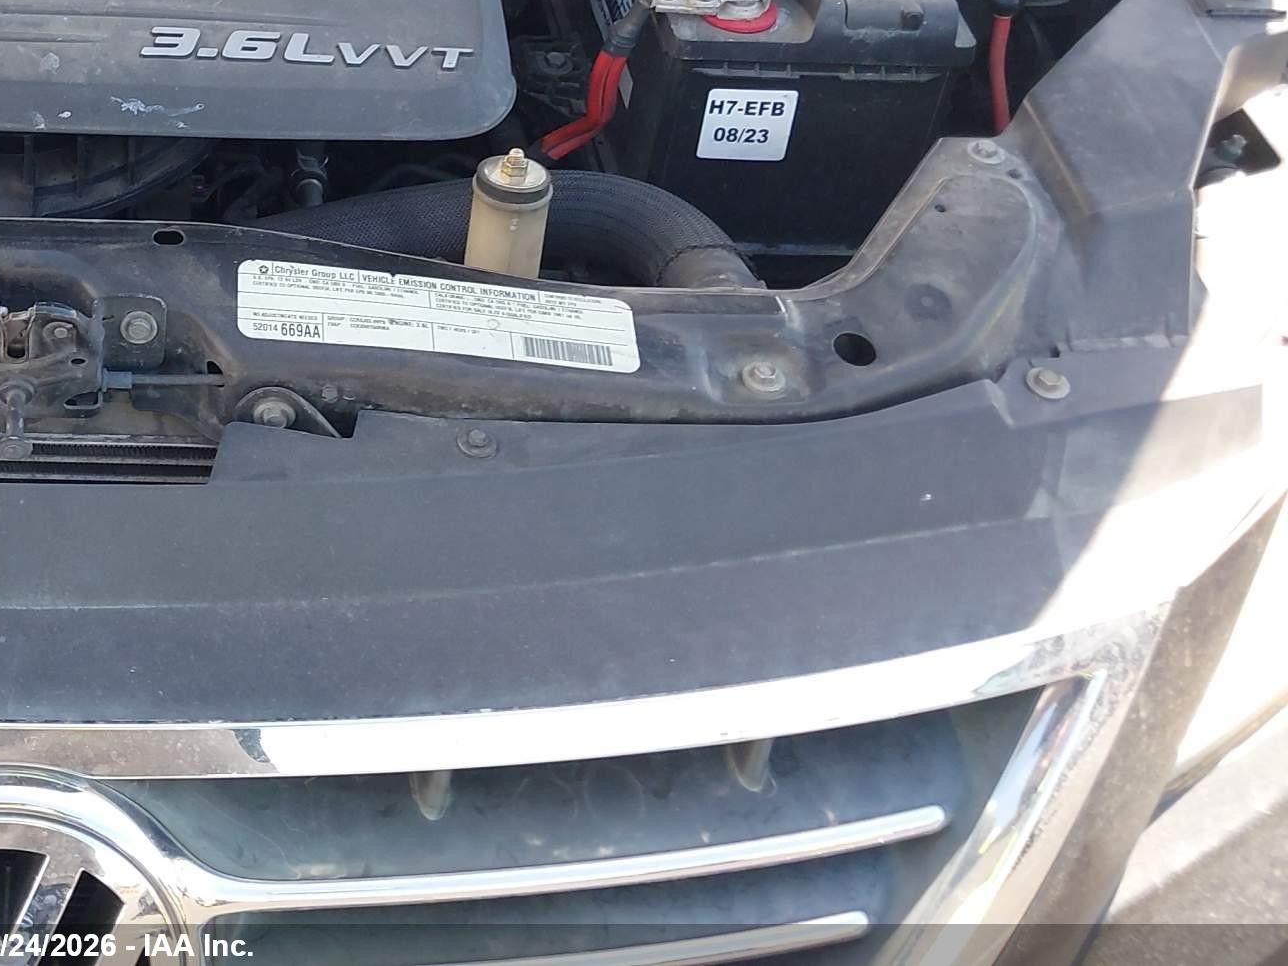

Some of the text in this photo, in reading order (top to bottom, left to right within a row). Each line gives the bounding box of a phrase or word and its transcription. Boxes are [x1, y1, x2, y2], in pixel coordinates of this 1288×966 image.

[708, 100, 786, 117] H7-EFB
[713, 127, 770, 144] 08/23
[274, 265, 309, 277] Chrysler
[311, 268, 337, 281] Group
[339, 272, 355, 281] LLC
[362, 273, 395, 285] VEHICLE
[398, 278, 438, 290] EMISSION
[440, 283, 479, 294] CONTROL
[480, 287, 536, 301] INFORMATION
[253, 322, 278, 331] 52014
[280, 322, 321, 339] 669AA
